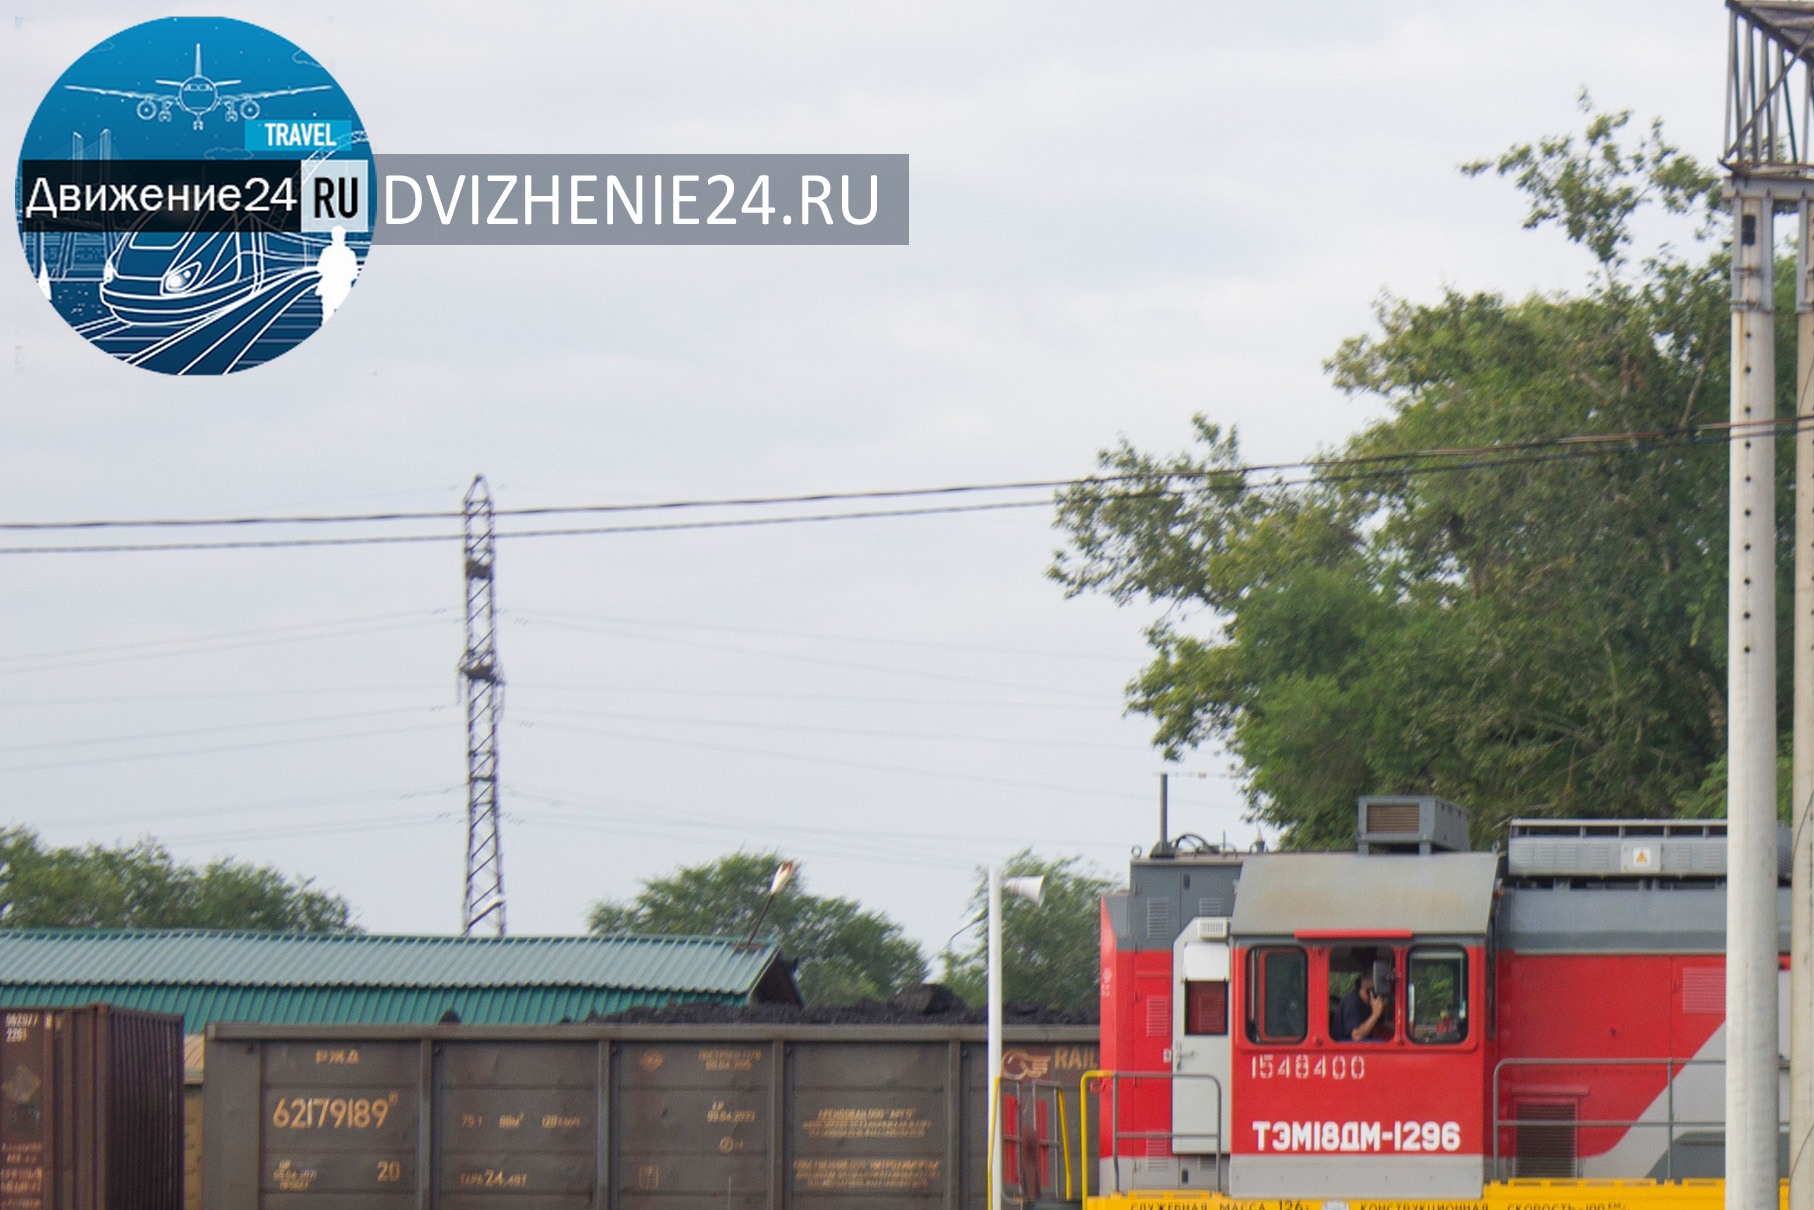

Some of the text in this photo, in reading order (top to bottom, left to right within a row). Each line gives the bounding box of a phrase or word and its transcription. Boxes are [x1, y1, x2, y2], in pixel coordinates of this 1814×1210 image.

[1251, 1054, 1365, 1080] 1548400
[272, 1098, 389, 1129] 62179189
[1251, 1121, 1462, 1152] ТЭМ18ДМ-1296
[377, 1161, 400, 1181] 20
